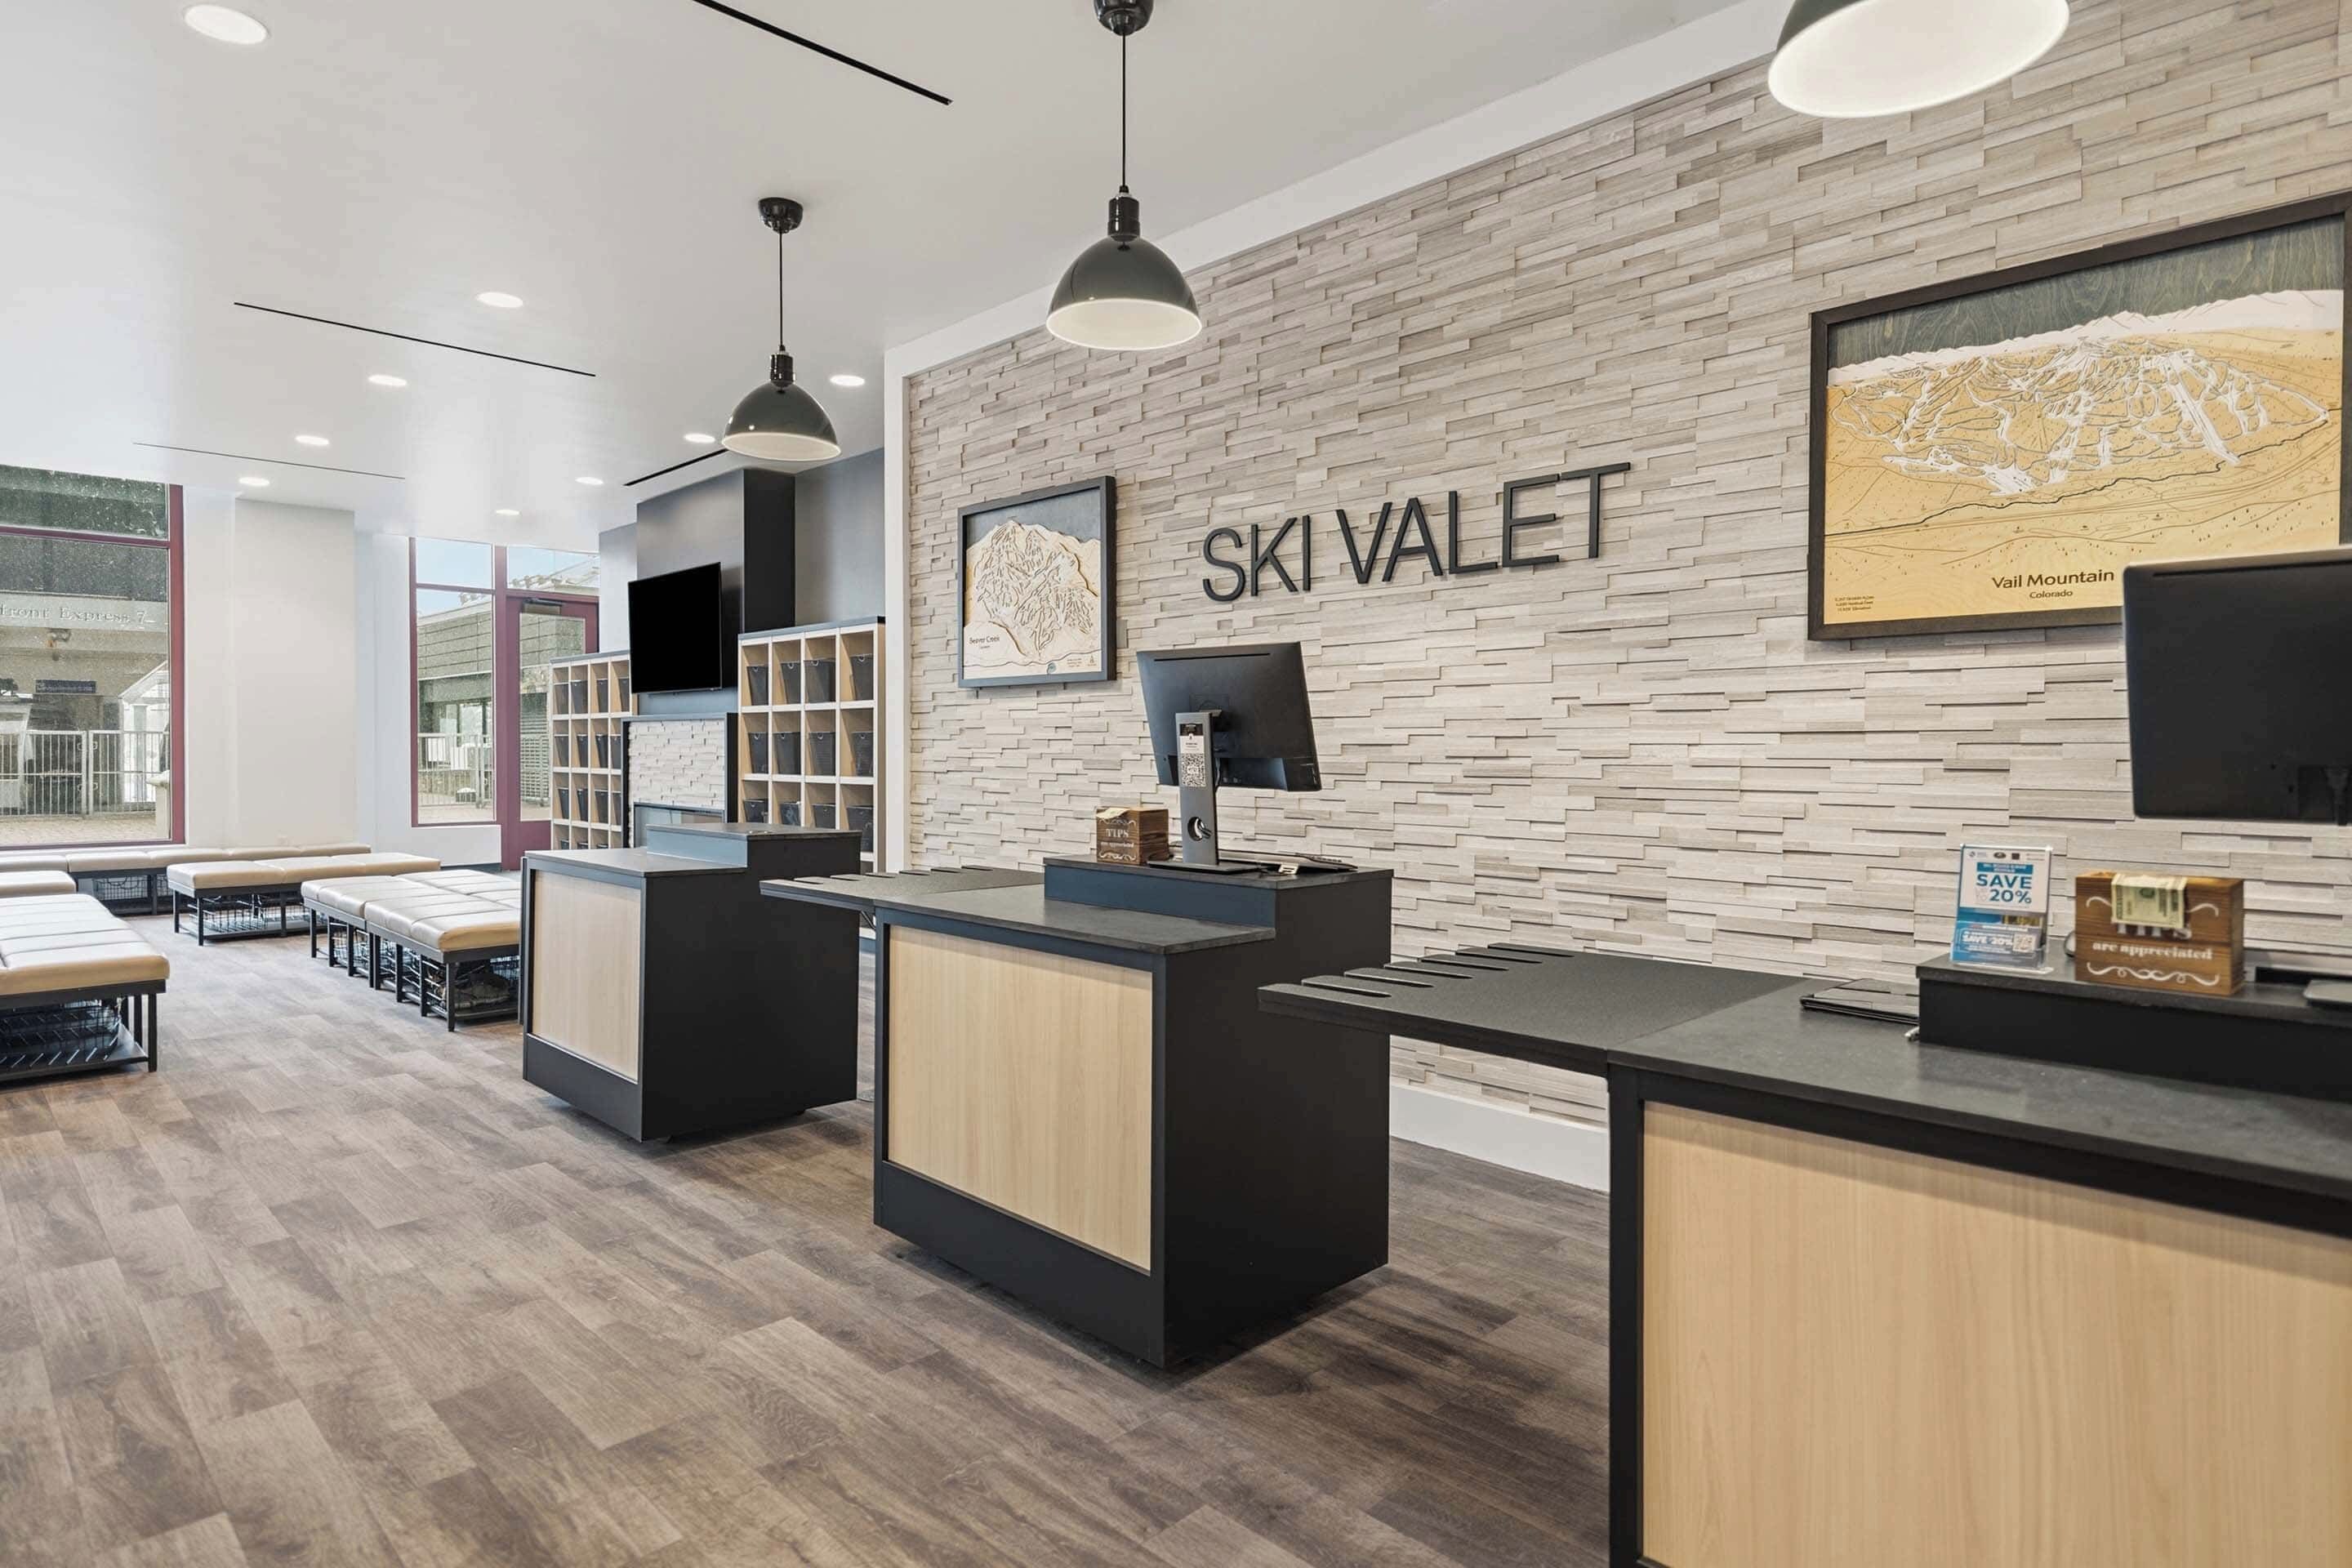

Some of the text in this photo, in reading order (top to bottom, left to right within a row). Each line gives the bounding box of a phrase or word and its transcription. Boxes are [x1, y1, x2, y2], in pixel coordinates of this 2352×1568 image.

[1202, 461, 1631, 602] SKI VALET
[1992, 569, 2114, 589] Vail Mountain
[2029, 590, 2073, 599] Colorado
[60, 607, 131, 622] Express
[136, 610, 148, 623] 7
[1105, 828, 1129, 838] TIPS
[1976, 874, 2033, 889] SAVE
[1989, 889, 2032, 904] 20%
[2092, 942, 2214, 960] are appreciated
